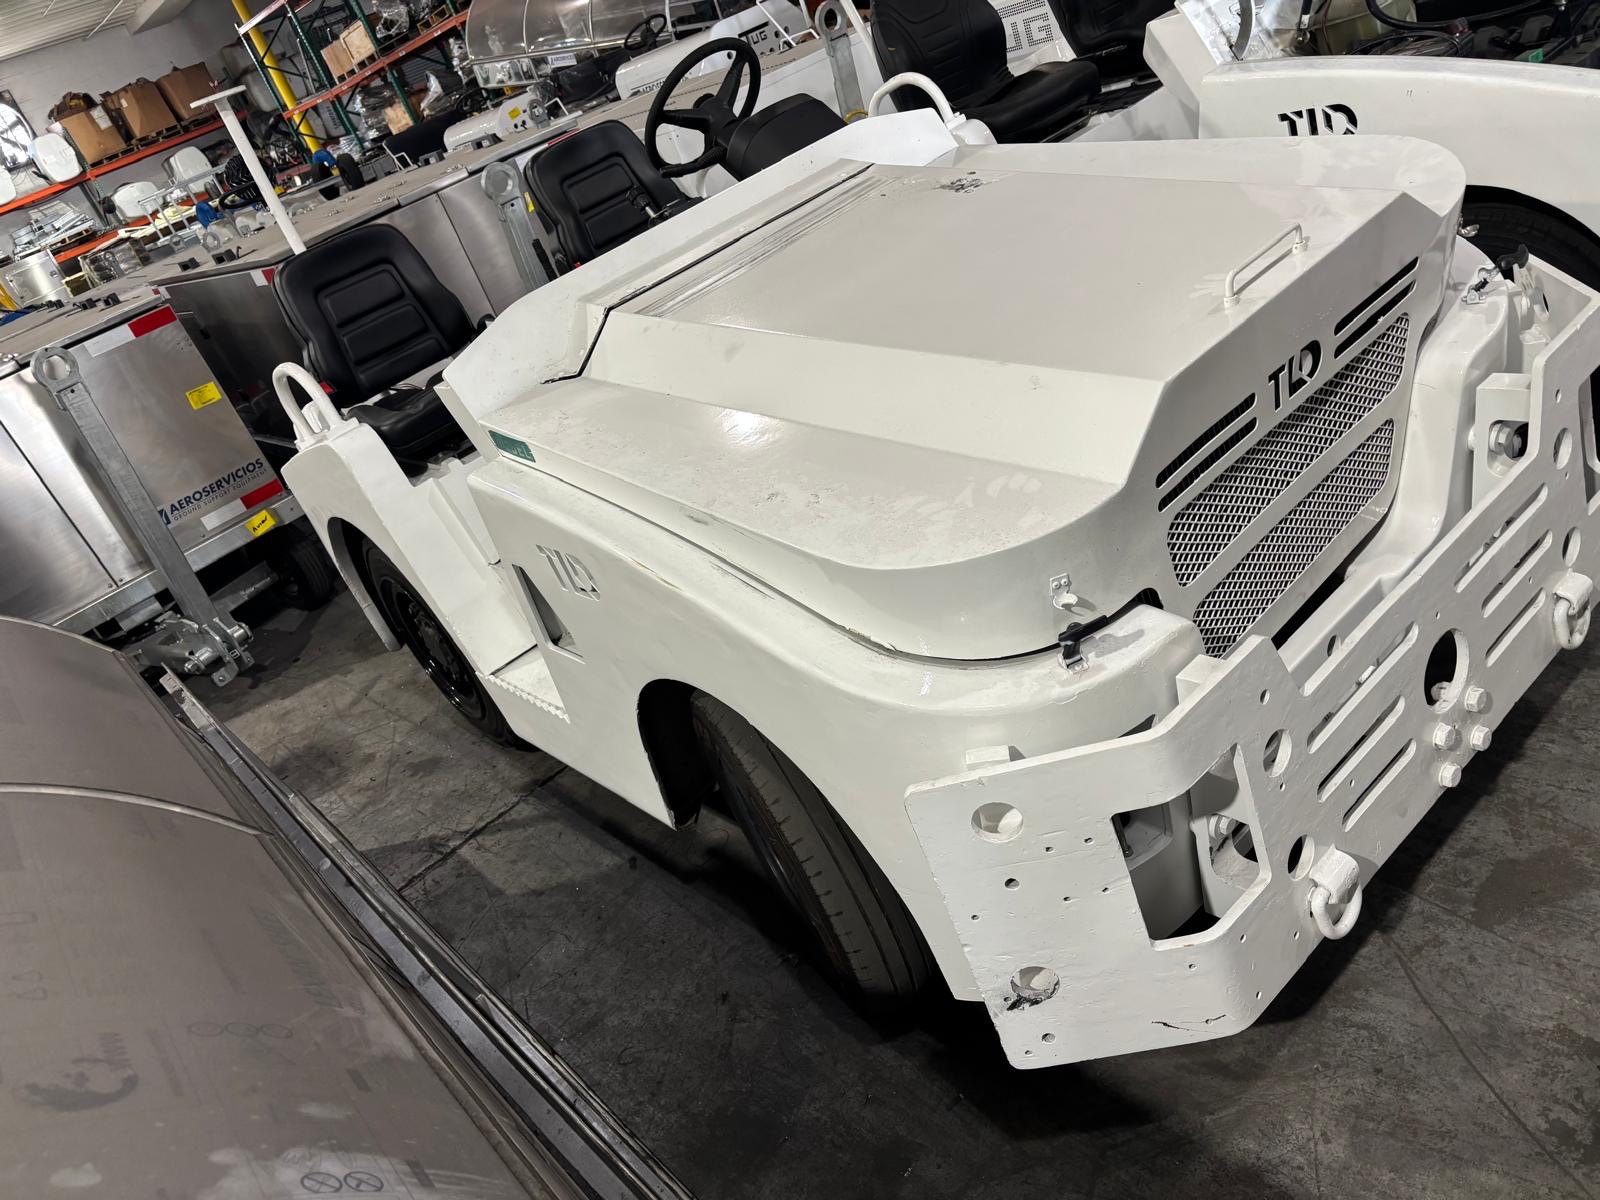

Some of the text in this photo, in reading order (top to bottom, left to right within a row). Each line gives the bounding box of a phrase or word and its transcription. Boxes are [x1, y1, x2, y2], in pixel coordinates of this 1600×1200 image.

[1268, 339, 1322, 412] TLD
[170, 457, 264, 515] AEROSERVICIOS
[173, 468, 268, 521] GROUND SUPPORT EQUIPMENT
[535, 543, 601, 601] TLD
